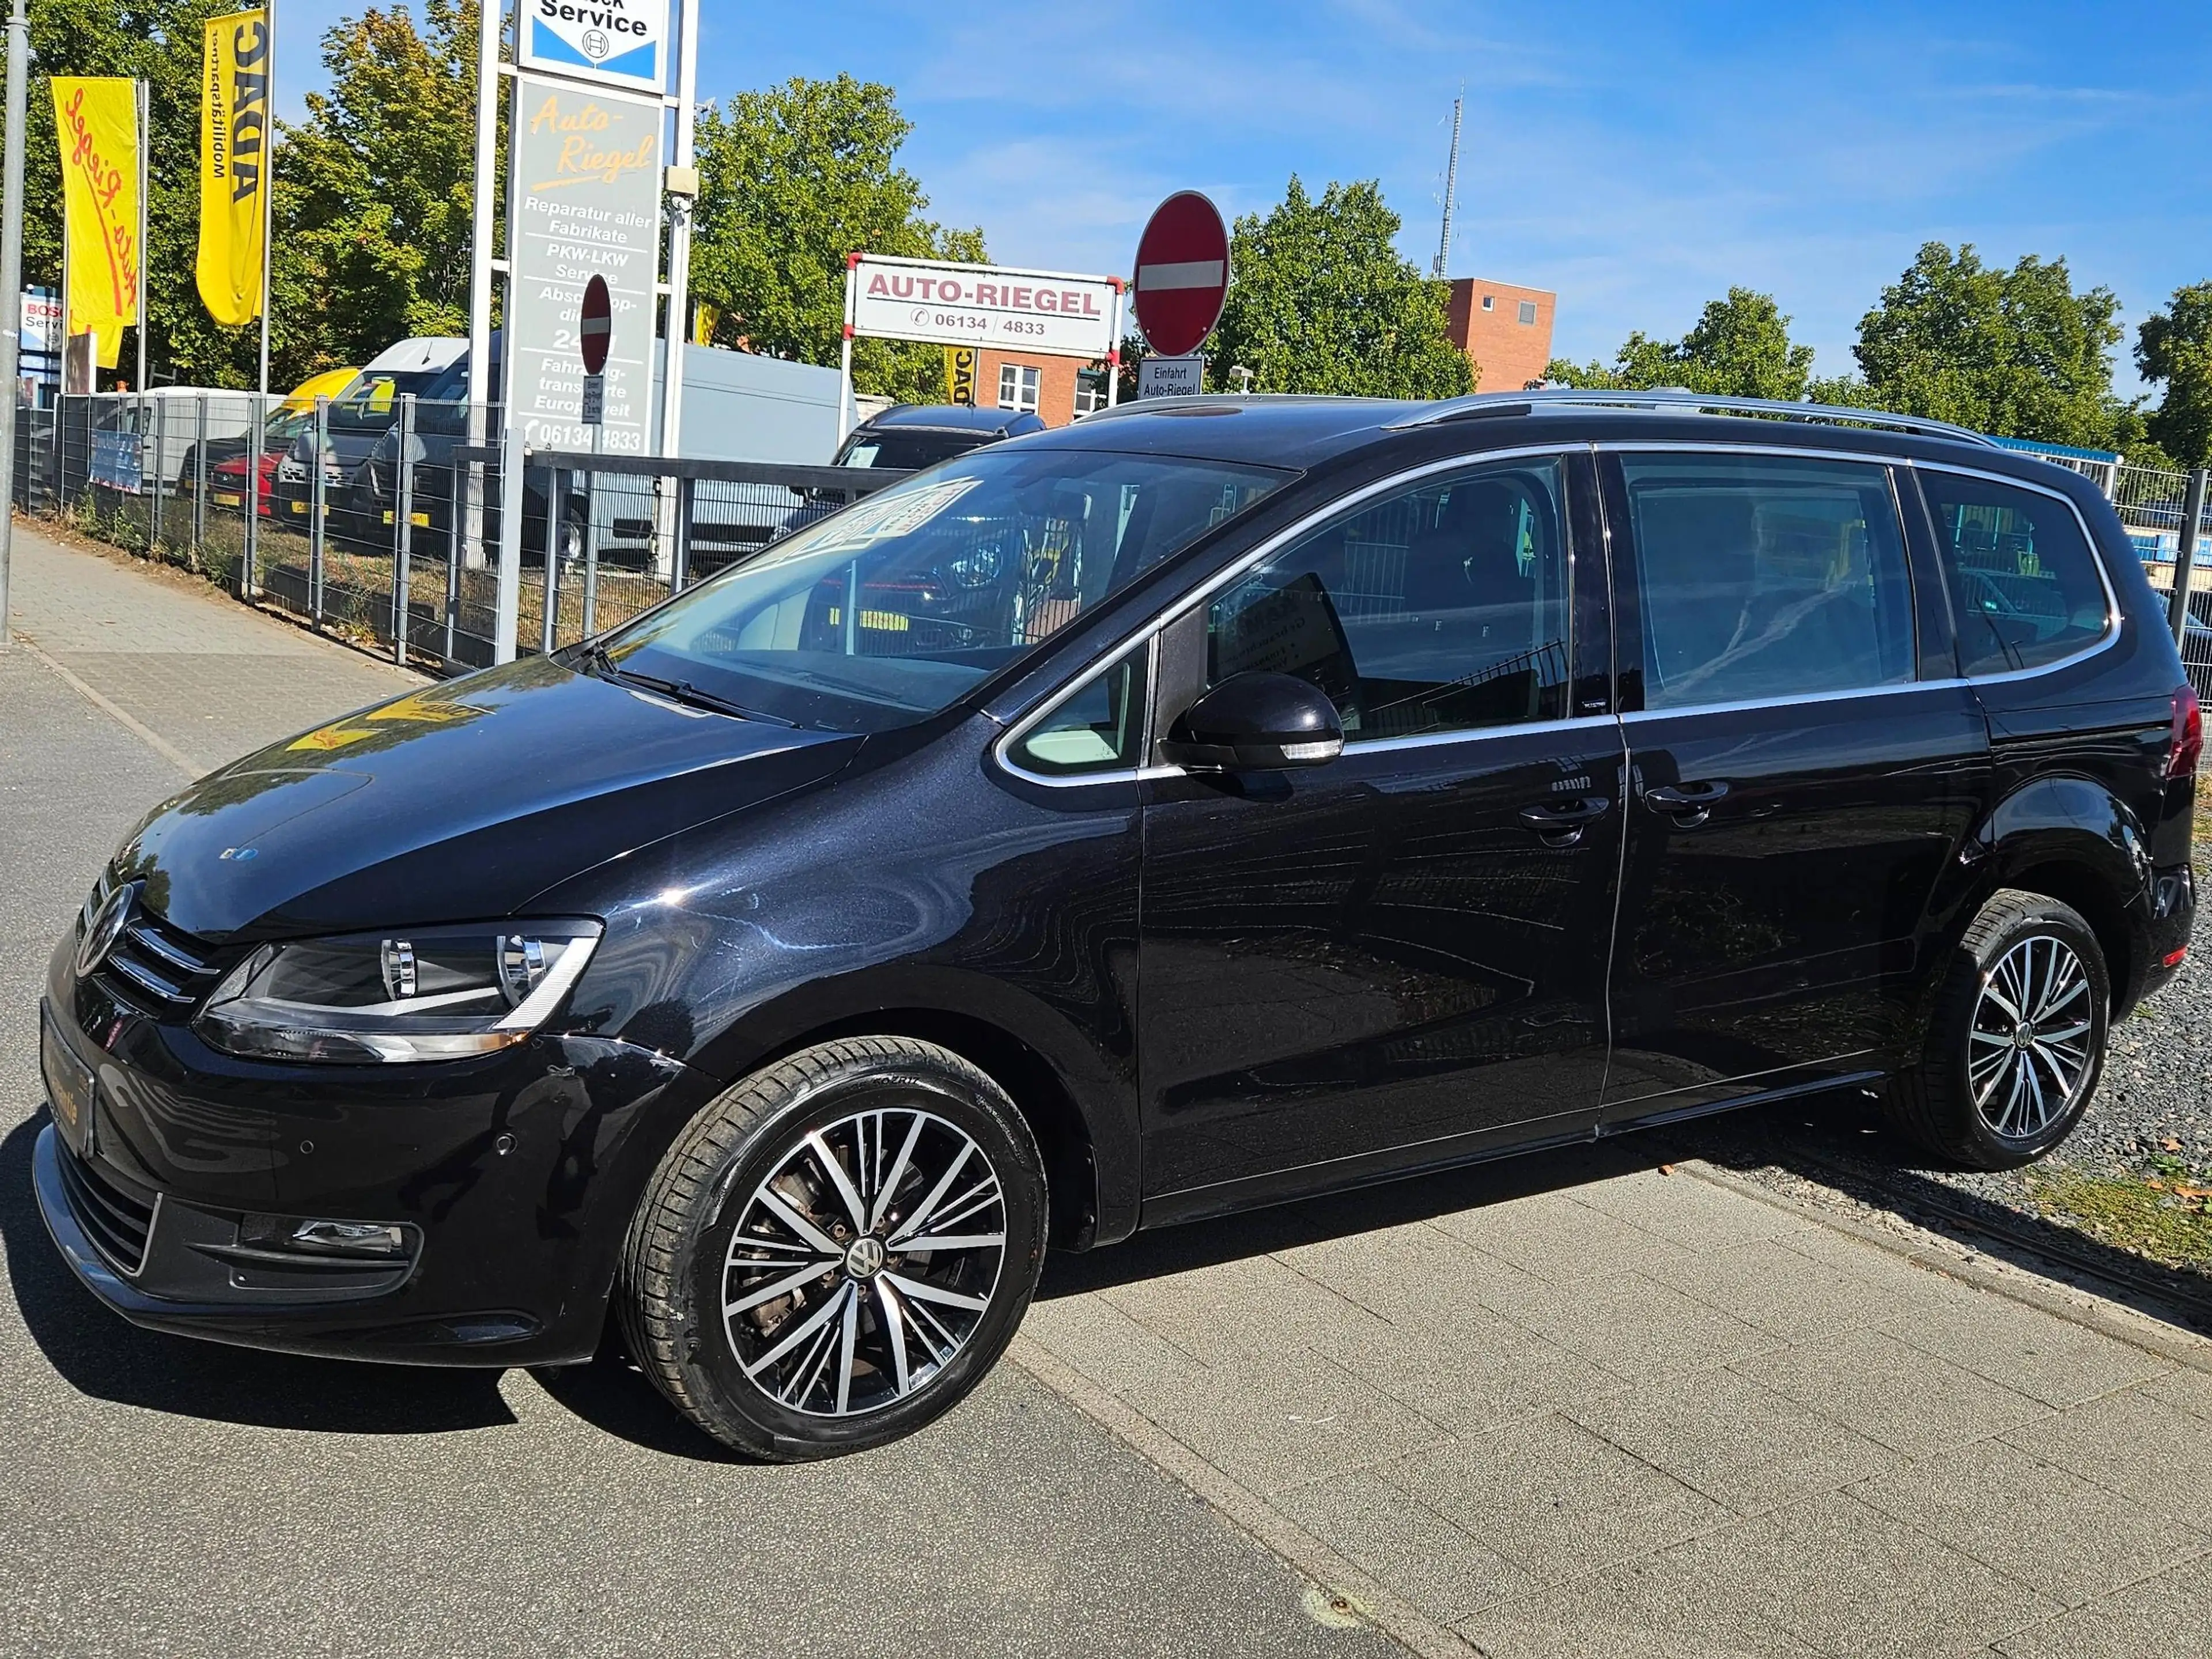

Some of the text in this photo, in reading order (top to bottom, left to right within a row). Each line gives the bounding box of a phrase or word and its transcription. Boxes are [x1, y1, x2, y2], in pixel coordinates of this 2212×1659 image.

[540, 0, 647, 36] Service
[557, 135, 654, 184] Riegel
[524, 196, 653, 229] Reparatur aller
[549, 220, 627, 243] Fabrikate
[546, 243, 629, 267] PKW-LKW
[867, 274, 1101, 315] AUTO-RIEGEL
[935, 314, 987, 330] 06134
[1003, 320, 1045, 336] 4833
[1154, 368, 1186, 379] Einfahrt
[1143, 383, 1195, 396] Auto-Riegel
[534, 395, 630, 418] Europeit
[539, 424, 593, 446] 06134
